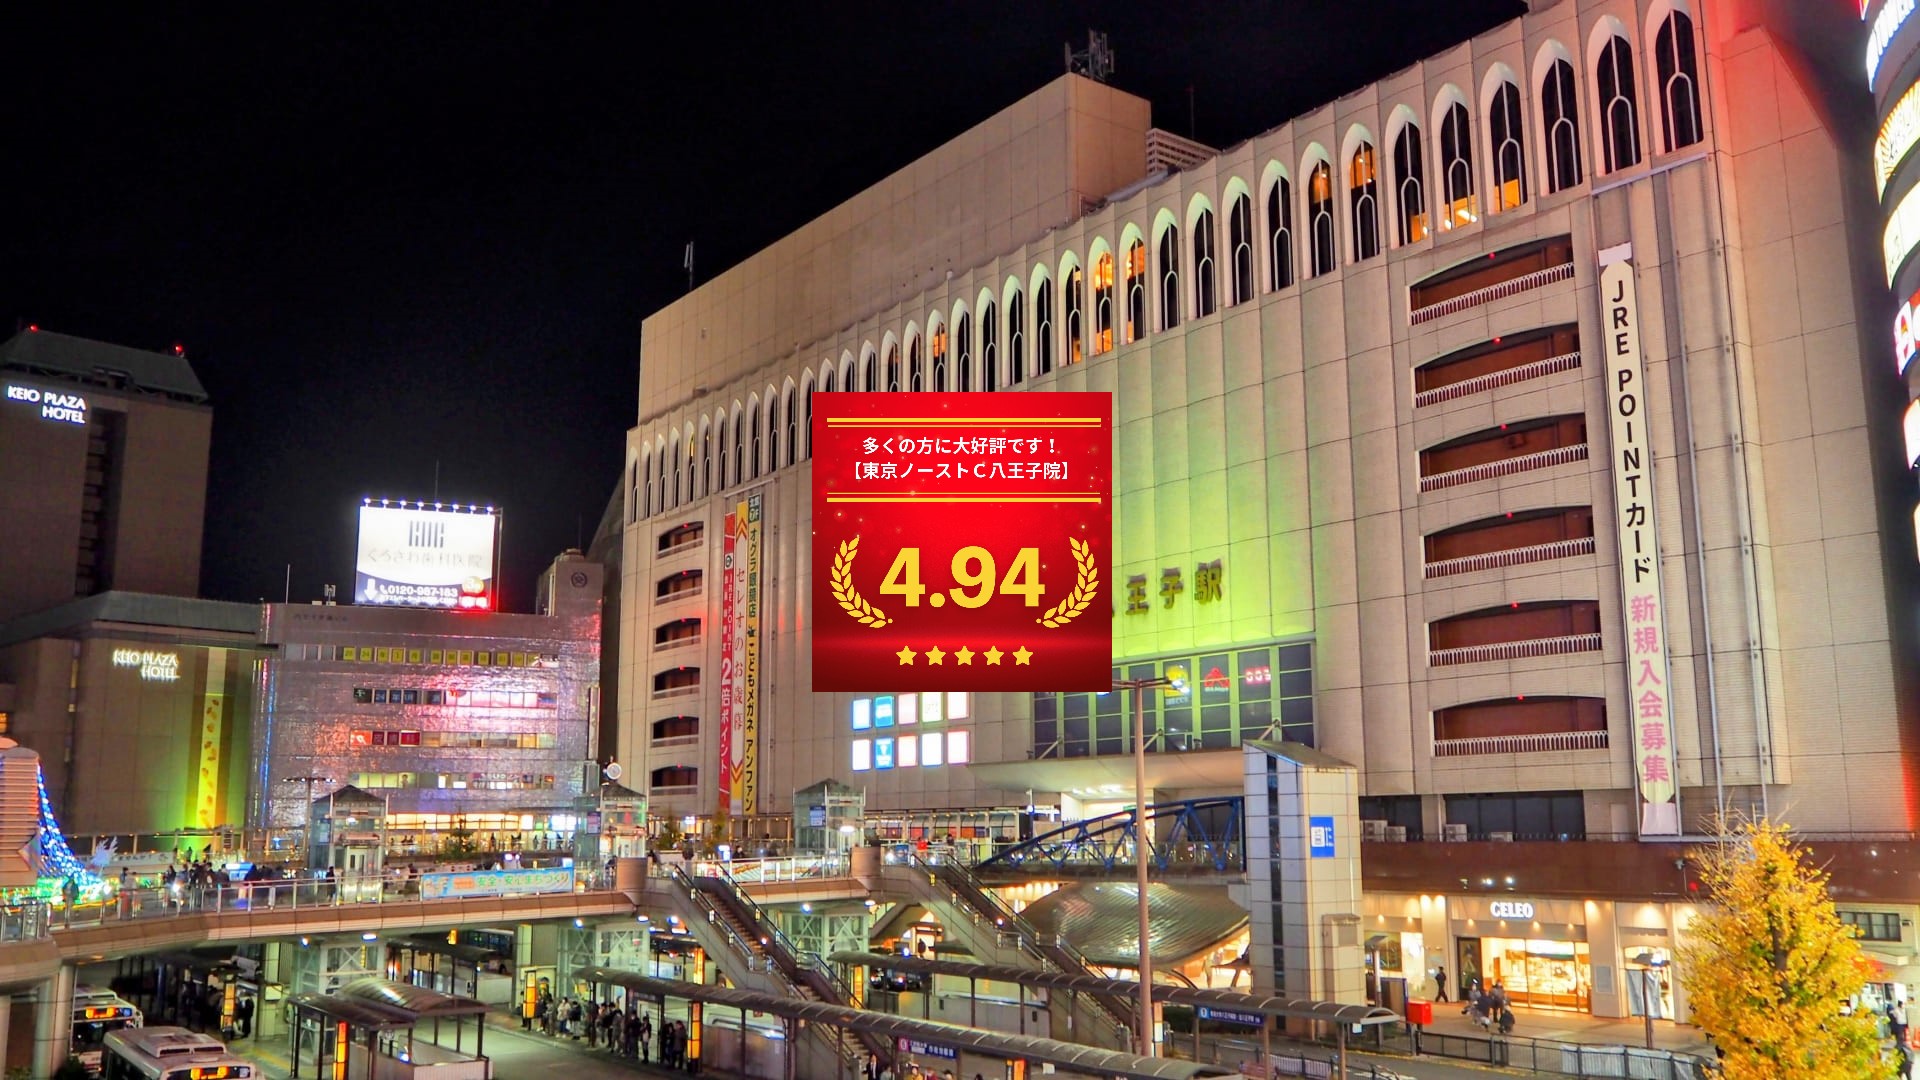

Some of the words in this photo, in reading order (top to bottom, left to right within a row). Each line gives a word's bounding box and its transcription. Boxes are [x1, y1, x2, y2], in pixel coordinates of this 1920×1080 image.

[1612, 280, 1630, 356] JRE
[8, 385, 40, 402] KEIO
[44, 391, 86, 411] PLAZA
[42, 405, 86, 424] HOTEL
[1618, 368, 1651, 583] POINTカード
[112, 648, 140, 667] KEIO
[142, 650, 178, 668] PLAZA
[141, 664, 181, 682] HOTEL
[1631, 594, 1669, 783] 新規入会募集
[720, 657, 732, 774] 2倍ポイント
[745, 739, 754, 812] アンファン
[1490, 901, 1534, 919] CELEO
